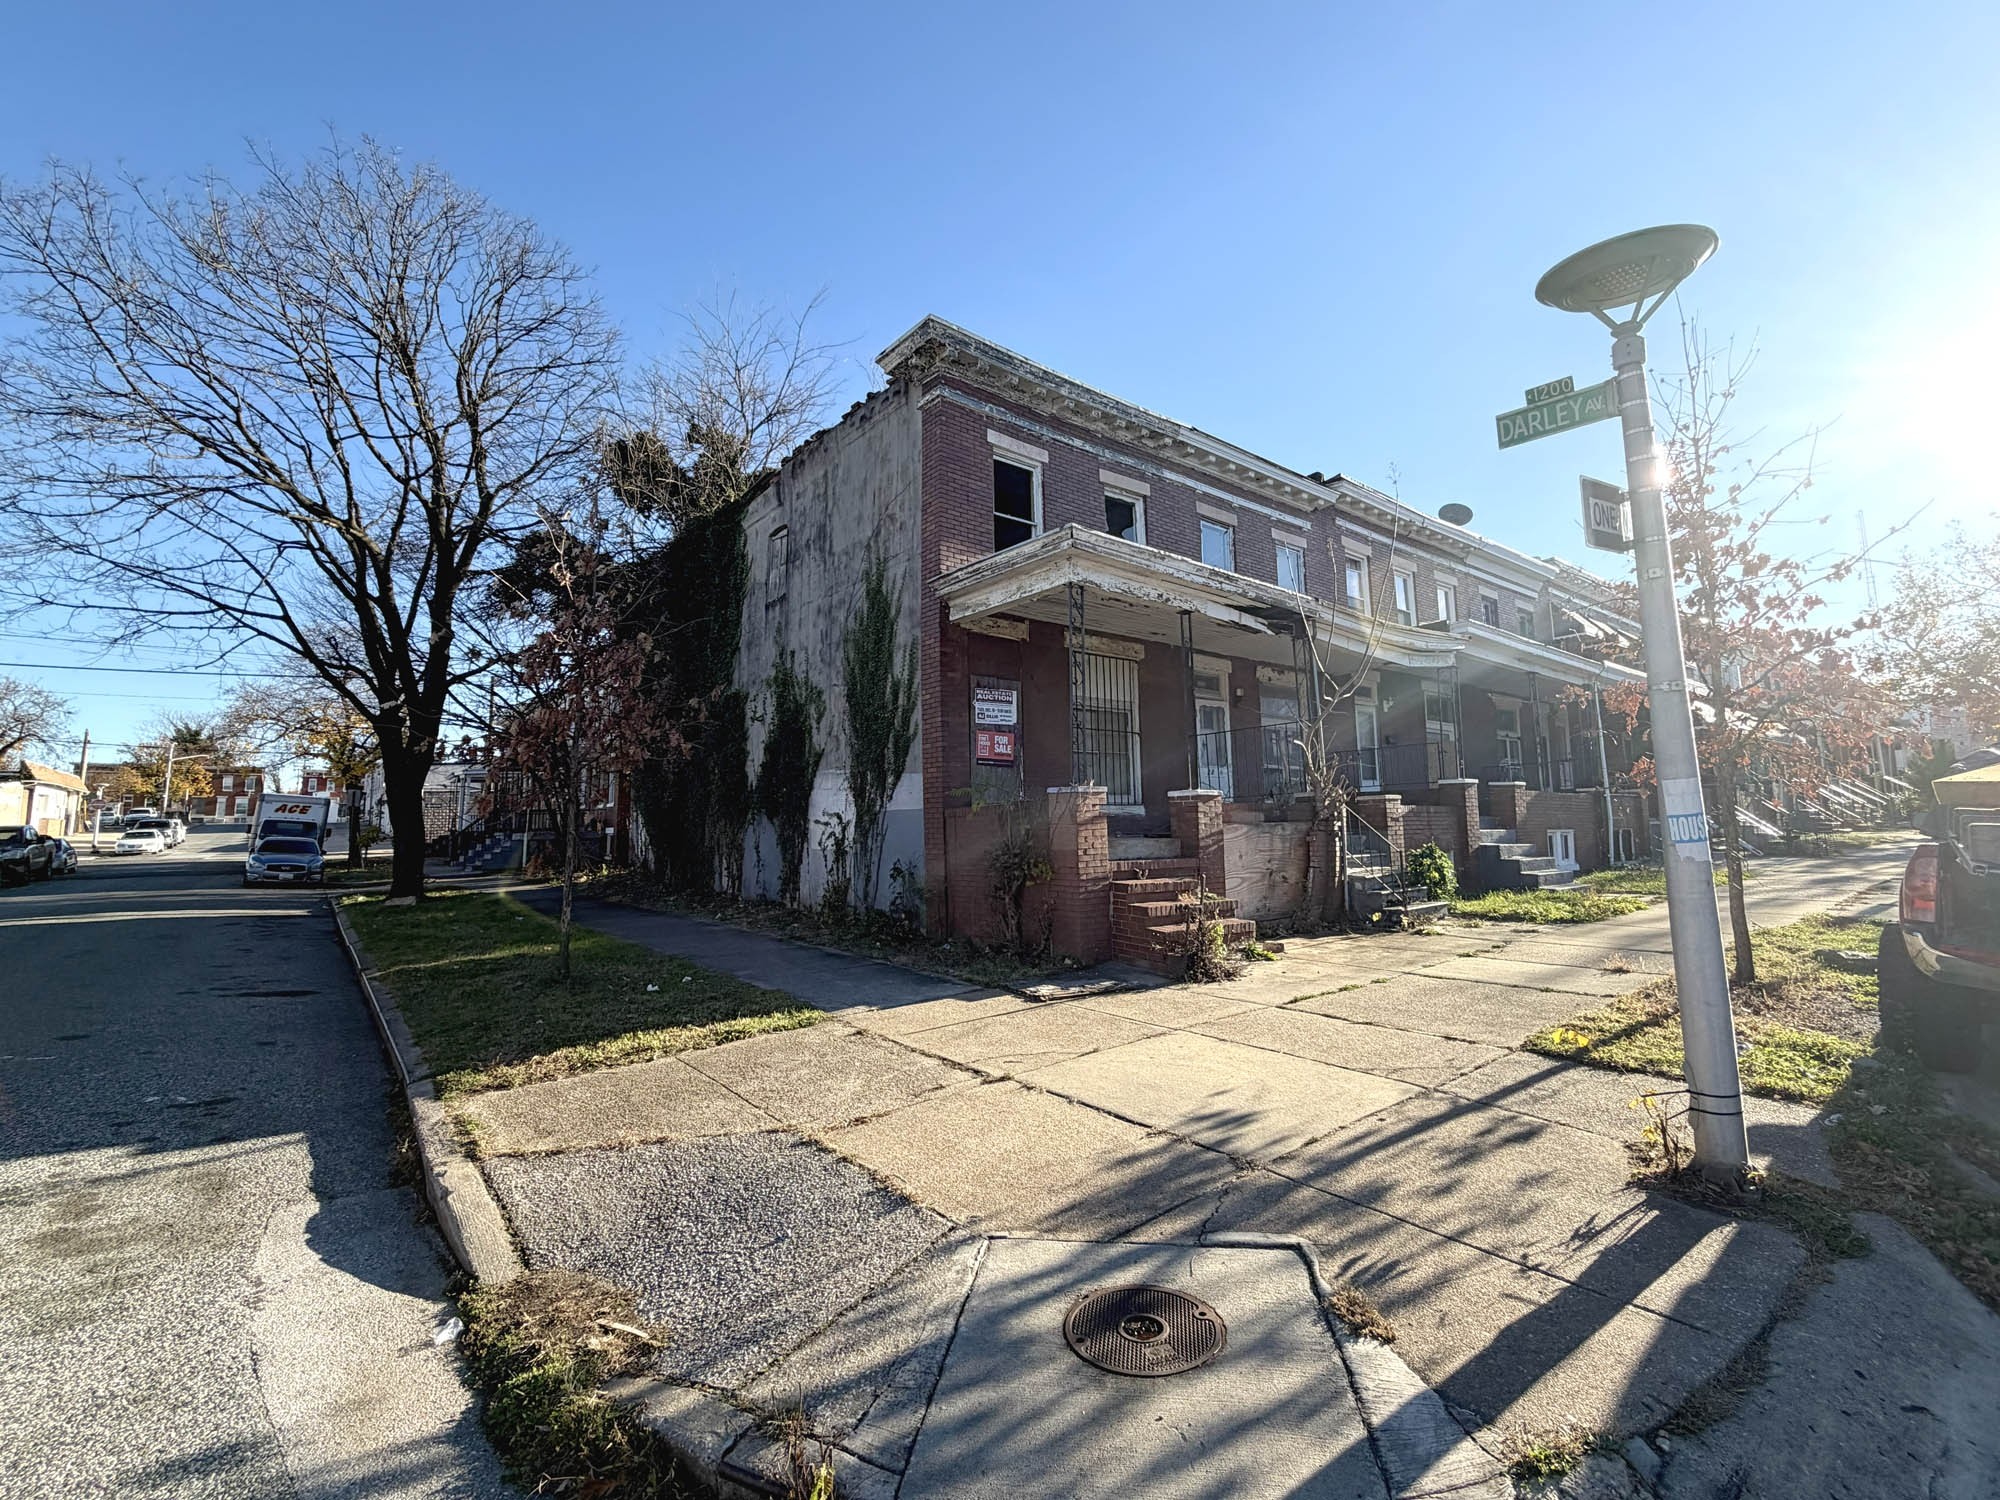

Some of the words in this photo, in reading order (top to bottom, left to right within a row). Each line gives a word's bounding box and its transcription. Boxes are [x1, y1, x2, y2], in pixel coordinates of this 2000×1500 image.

[1534, 378, 1572, 401] 1200
[1500, 397, 1584, 442] DARLEY
[1593, 502, 1618, 529] ONE
[977, 694, 1012, 702] AUCTION
[994, 735, 1008, 744] FOR
[994, 744, 1012, 753] SALE
[274, 804, 312, 814] ACE
